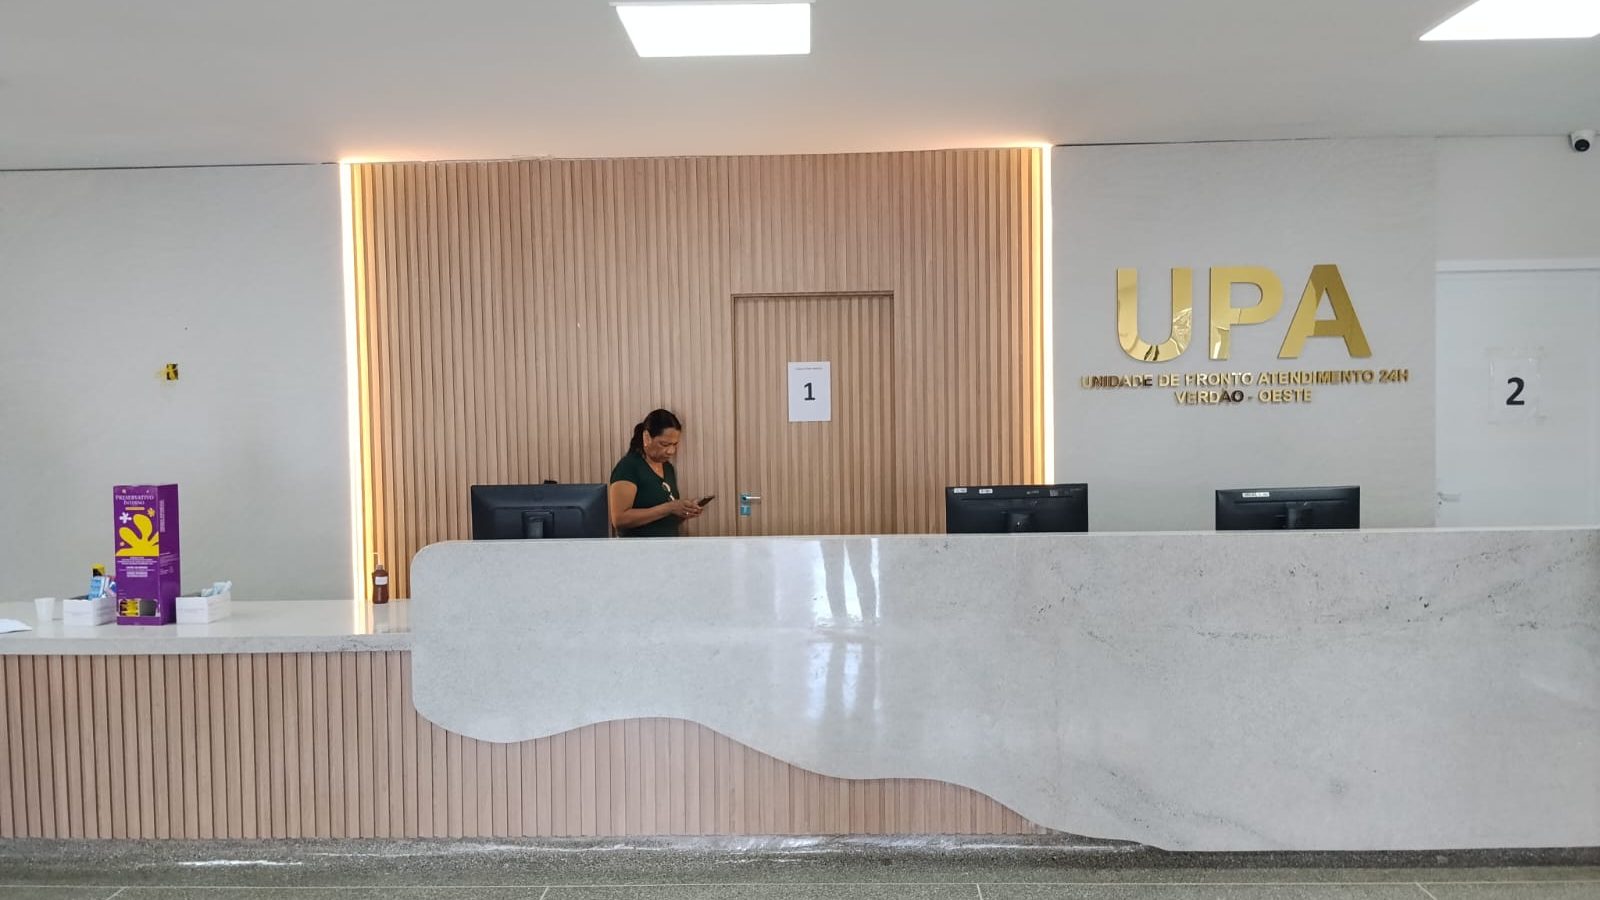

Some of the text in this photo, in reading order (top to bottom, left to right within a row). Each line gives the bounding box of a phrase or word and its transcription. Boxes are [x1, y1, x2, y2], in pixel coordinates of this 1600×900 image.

[1116, 264, 1372, 362] UPA
[1081, 369, 1409, 389] UNIDADE DE PRONTO ATENDIMENTO 24H
[804, 382, 816, 401] 1
[1258, 389, 1312, 403] OESTE
[1506, 377, 1525, 405] 2
